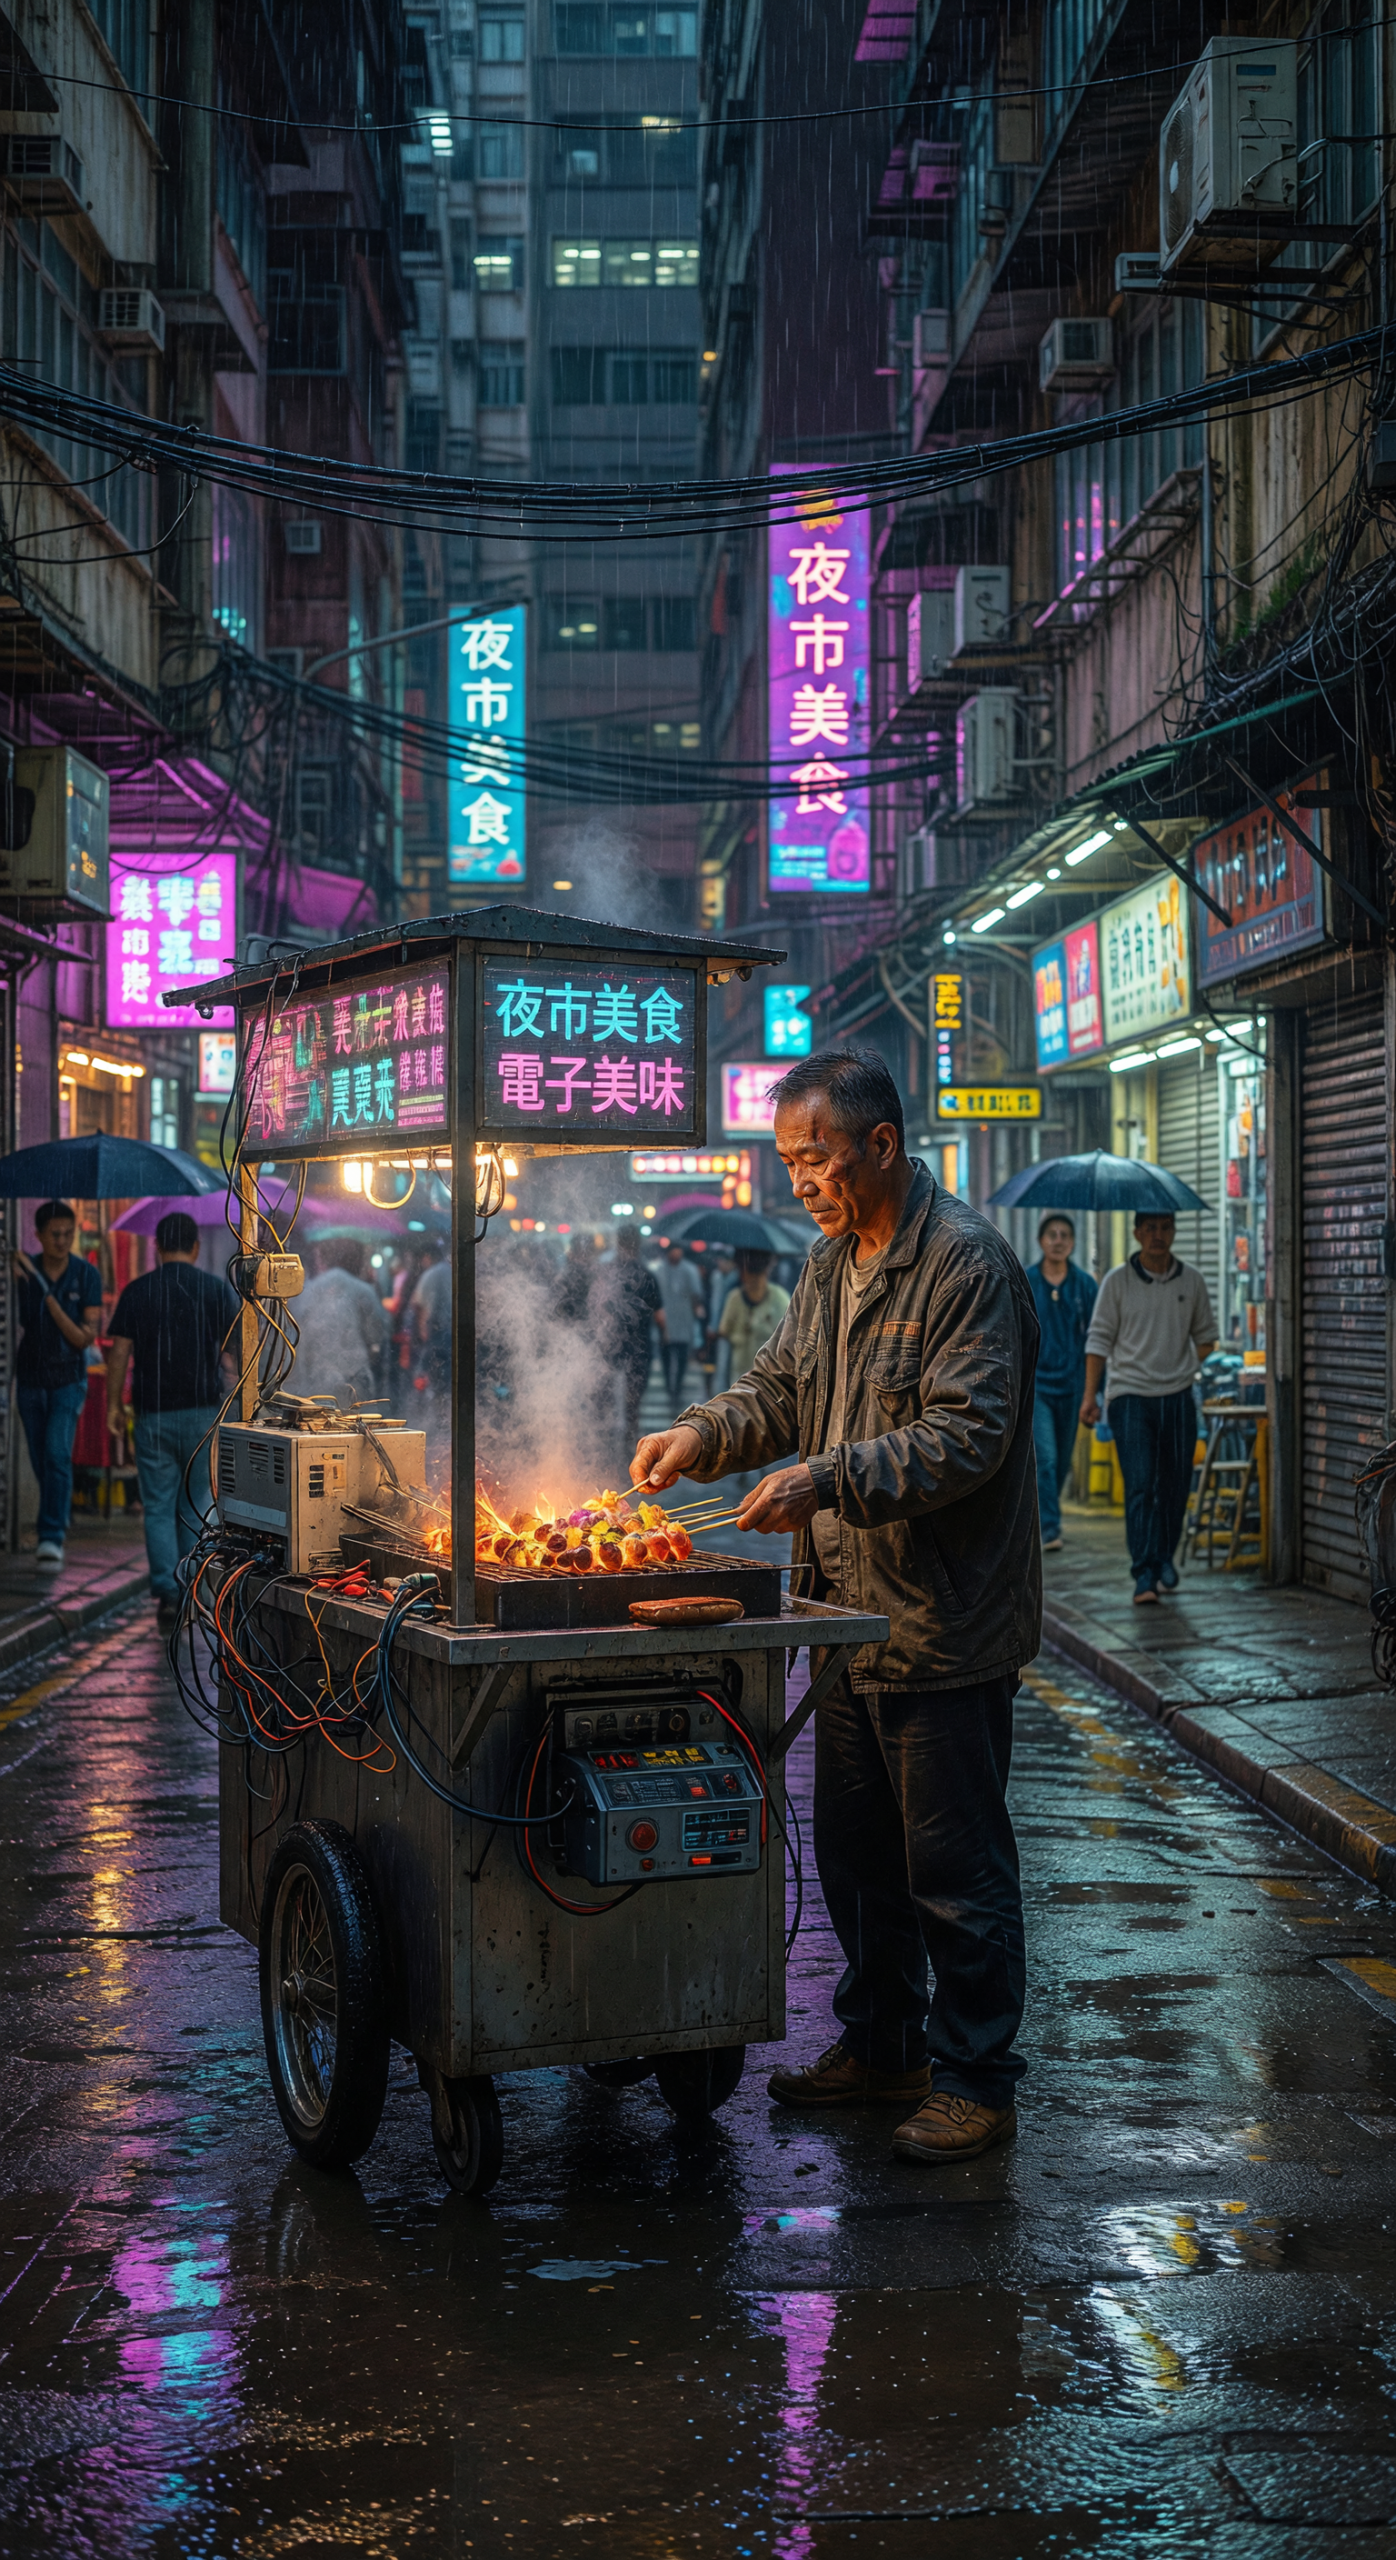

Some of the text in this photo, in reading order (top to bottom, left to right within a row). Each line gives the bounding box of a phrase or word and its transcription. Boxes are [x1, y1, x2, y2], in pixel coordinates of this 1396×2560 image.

[461, 619, 514, 845] 夜市美食
[787, 541, 851, 815] 夜市美食
[496, 978, 684, 1044] 夜市美食
[498, 1053, 685, 1115] 電子美味
